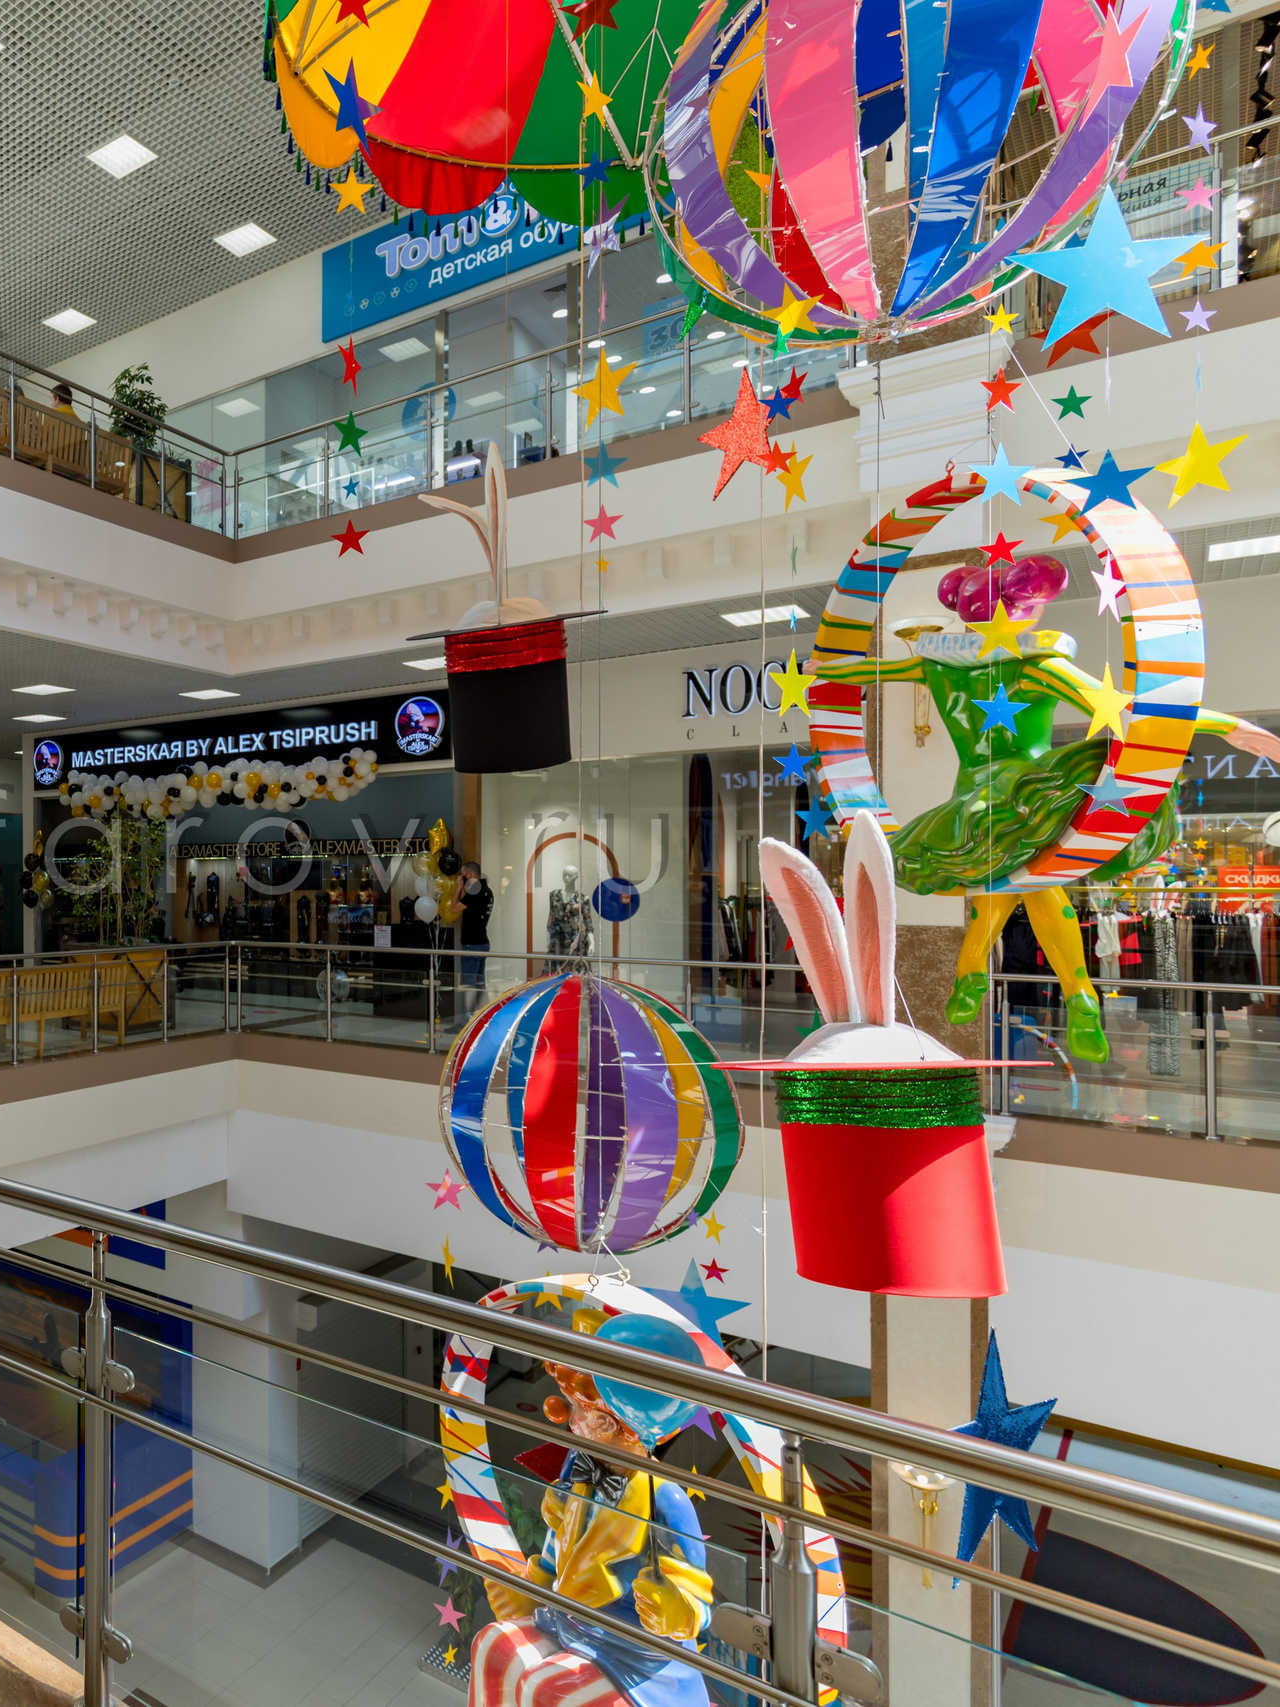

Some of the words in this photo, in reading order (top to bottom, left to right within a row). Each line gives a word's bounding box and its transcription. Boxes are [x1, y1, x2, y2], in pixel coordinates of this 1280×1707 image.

[1117, 176, 1167, 202] ьная
[428, 238, 514, 289] детская
[519, 219, 578, 249] обу
[681, 658, 812, 718] NOC
[185, 738, 211, 758] BY
[214, 732, 266, 755] ALEX
[269, 720, 378, 750] TSIPRUSH
[309, 838, 429, 855] ALEXMASTER.STO
[1225, 874, 1280, 886] СКИДК
